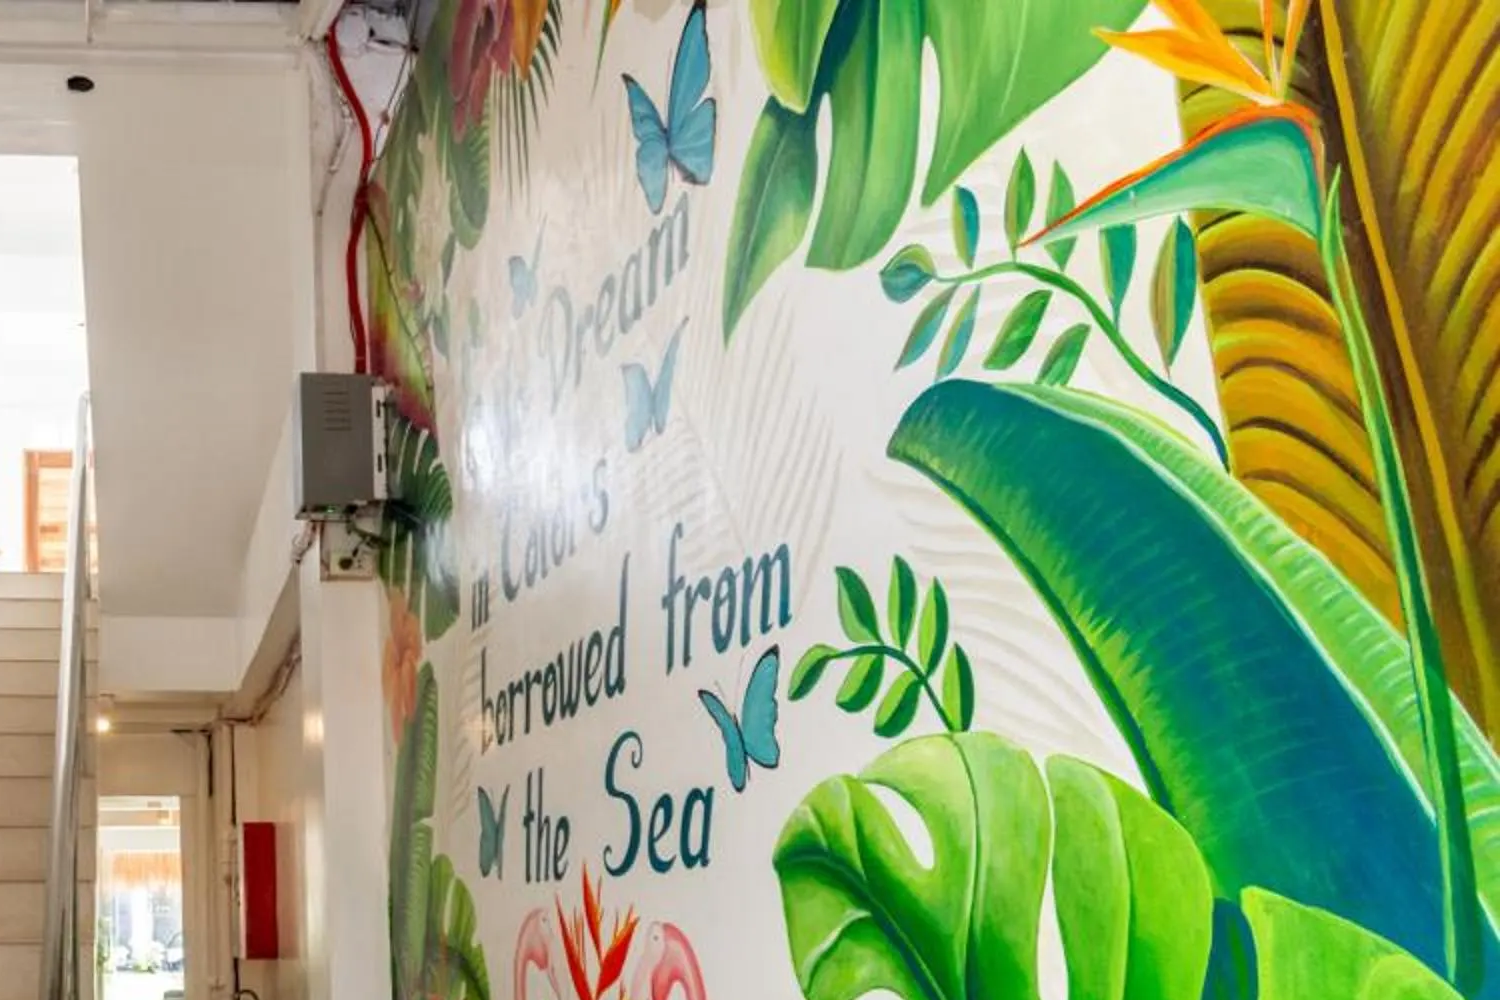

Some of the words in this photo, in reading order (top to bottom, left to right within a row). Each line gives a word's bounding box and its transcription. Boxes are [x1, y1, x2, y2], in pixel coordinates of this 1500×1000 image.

[537, 192, 691, 416] Dream
[480, 552, 632, 756] borrowed
[661, 522, 792, 676] from
[523, 767, 571, 884] the
[603, 730, 715, 877] Sea
